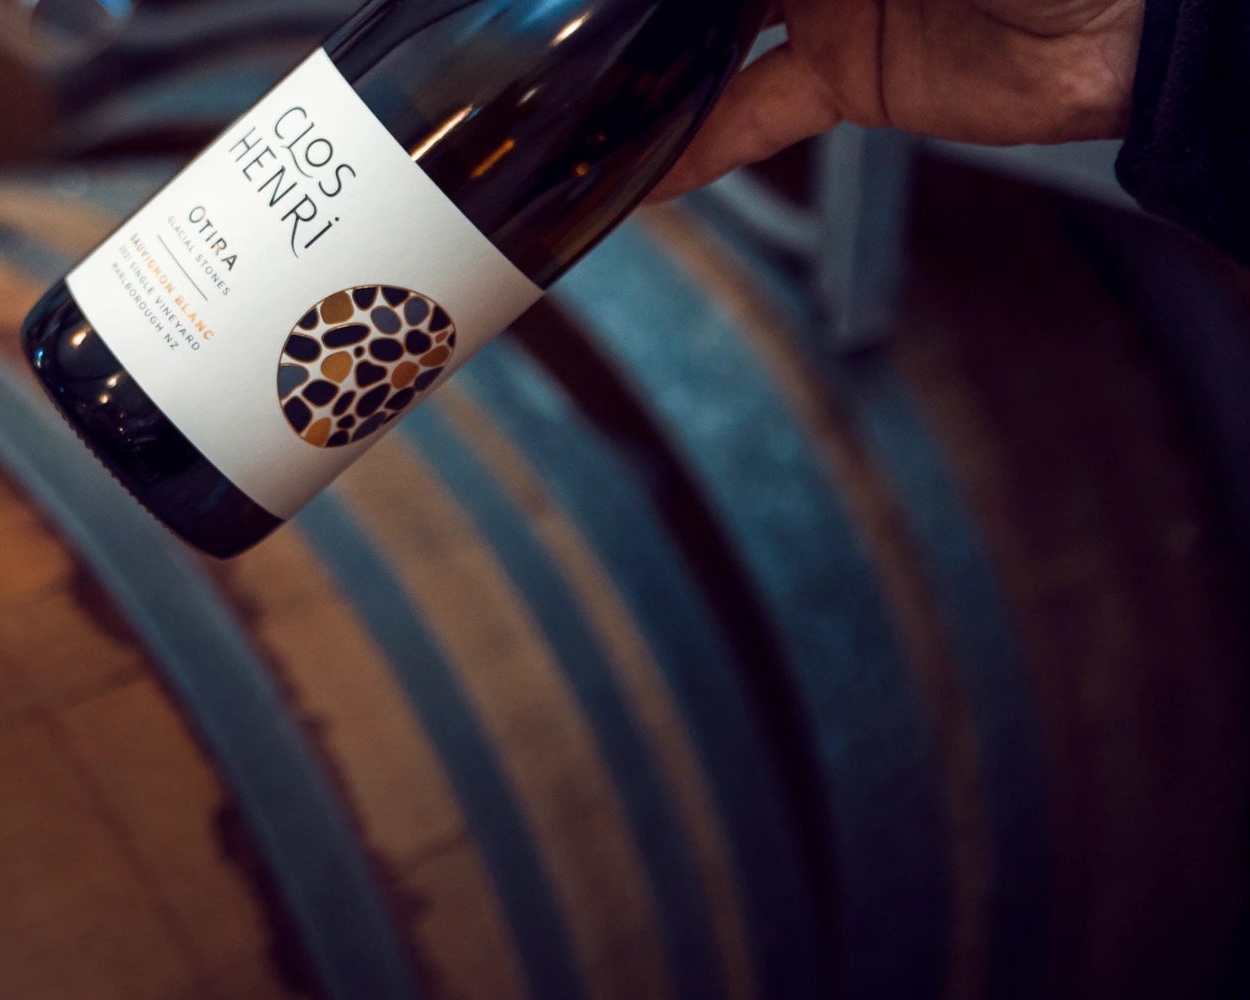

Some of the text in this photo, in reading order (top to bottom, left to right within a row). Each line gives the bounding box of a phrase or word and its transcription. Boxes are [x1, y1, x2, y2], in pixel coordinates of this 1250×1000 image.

[274, 106, 356, 197] CLOS
[167, 215, 231, 296] GLACIAL STONES
[188, 205, 238, 272] OTIRA
[112, 261, 180, 351] MARLBOROUGH NZ
[130, 233, 215, 342] SAUVIGNON BLANC
[130, 262, 155, 295] SINGLE
[155, 296, 200, 351] VINEYARD
